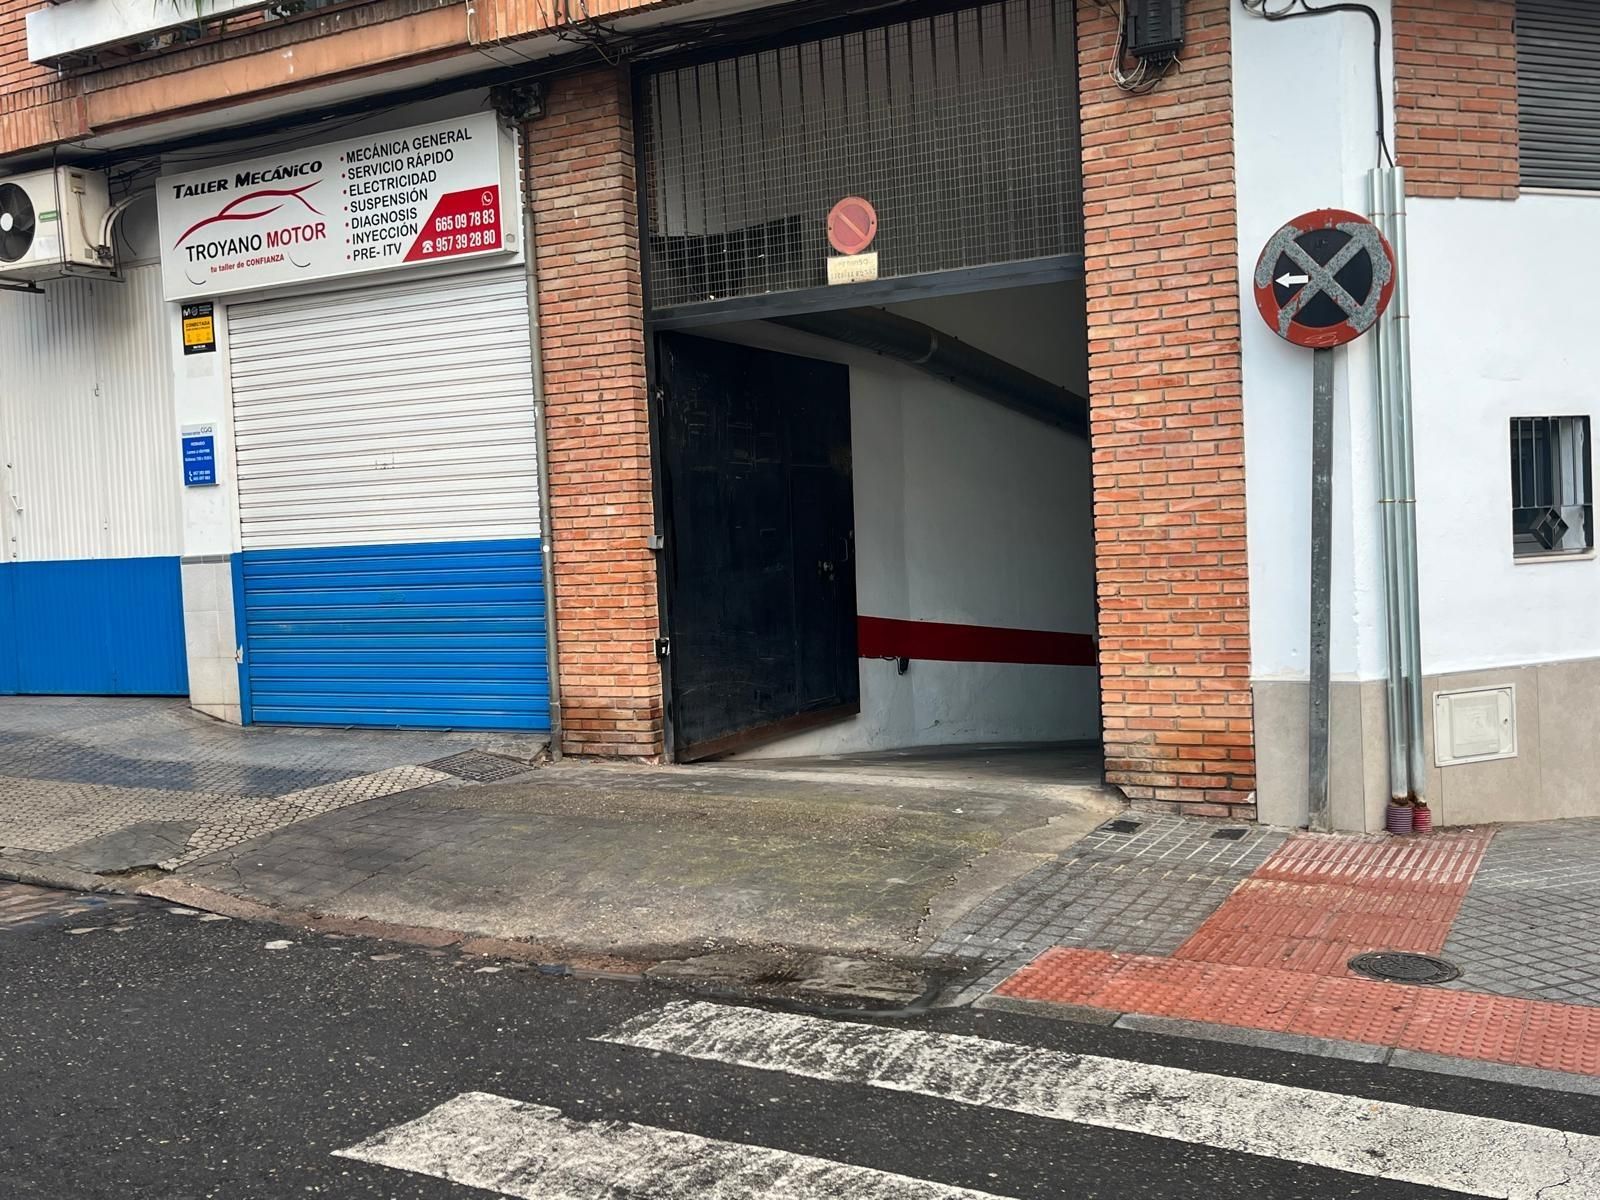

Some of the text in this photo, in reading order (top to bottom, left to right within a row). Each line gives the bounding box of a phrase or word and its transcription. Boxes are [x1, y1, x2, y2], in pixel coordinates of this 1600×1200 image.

[346, 128, 472, 163] MECÁNICA GENERAL
[348, 148, 454, 180] SERVICIO RÁPIDO
[173, 179, 228, 199] TALLER
[349, 169, 437, 196] ELECTRICIDAD
[350, 188, 428, 213] SUSPENSIÓN
[351, 207, 418, 229] DIAGNOSIS
[435, 209, 495, 232] 665 09 78 83
[185, 222, 326, 262] TROYANO MOTOR
[352, 222, 418, 245] INYECCIÓN
[436, 229, 496, 252] 957 39 28 80
[383, 242, 402, 257] ITV
[218, 263, 235, 272] taller
[236, 261, 244, 269] de
[246, 253, 285, 267] CONFIANZA
